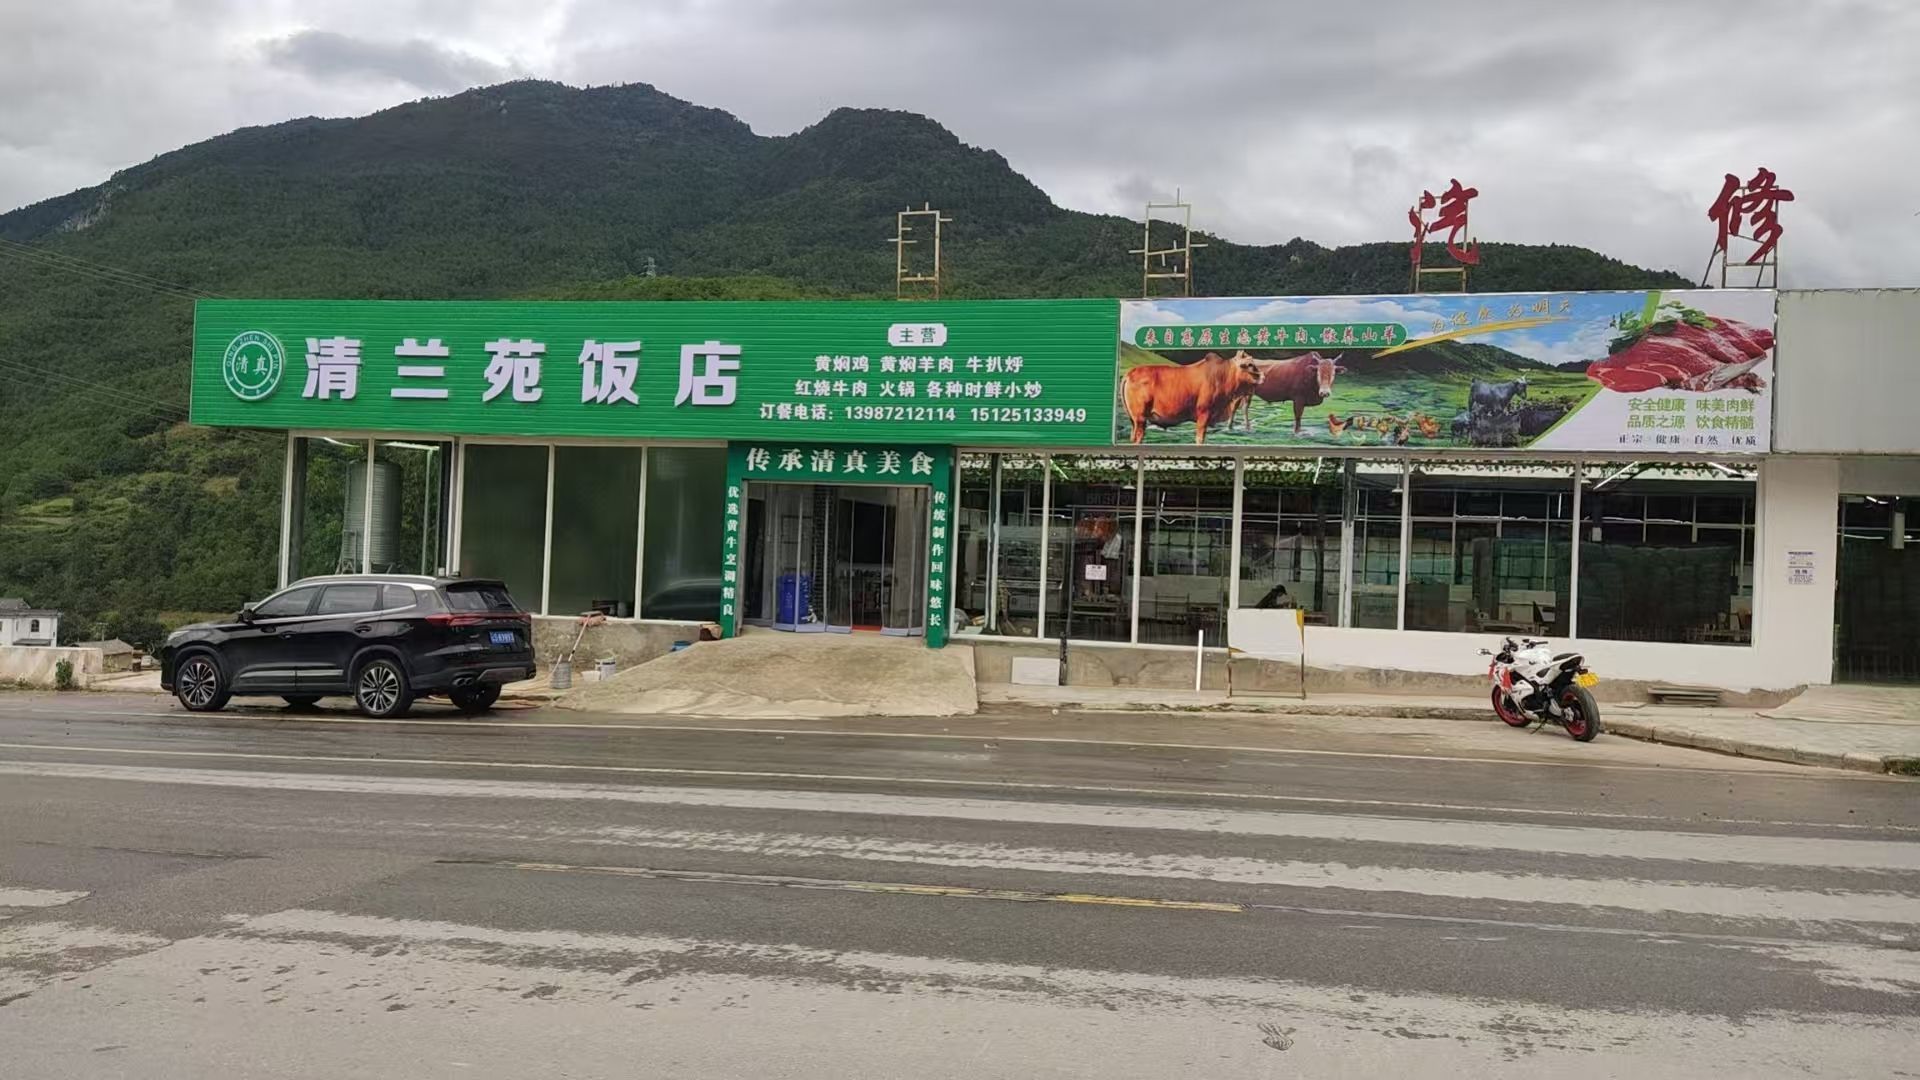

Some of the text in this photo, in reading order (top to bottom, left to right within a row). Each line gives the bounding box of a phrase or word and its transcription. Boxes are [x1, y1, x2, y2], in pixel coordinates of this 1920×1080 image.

[1408, 167, 1795, 265] 汽 修
[900, 327, 936, 343] 主营
[235, 354, 268, 375] 清真
[302, 337, 742, 407] 清兰苑饭店
[815, 355, 869, 372] 黄焖鸡
[880, 355, 953, 373] 黄焖羊肉
[794, 379, 1042, 398] 红烧牛肉 火锅 各种时鲜小炒
[845, 406, 956, 421] 13987212114
[971, 408, 1087, 422] 15125133949
[1628, 398, 1753, 412] 安全健康 味美肉鲜
[1627, 415, 1754, 429] 品质之源 饮食精髓
[746, 448, 935, 475] 传承清真美食
[929, 491, 946, 626] 传统制作回味悠长
